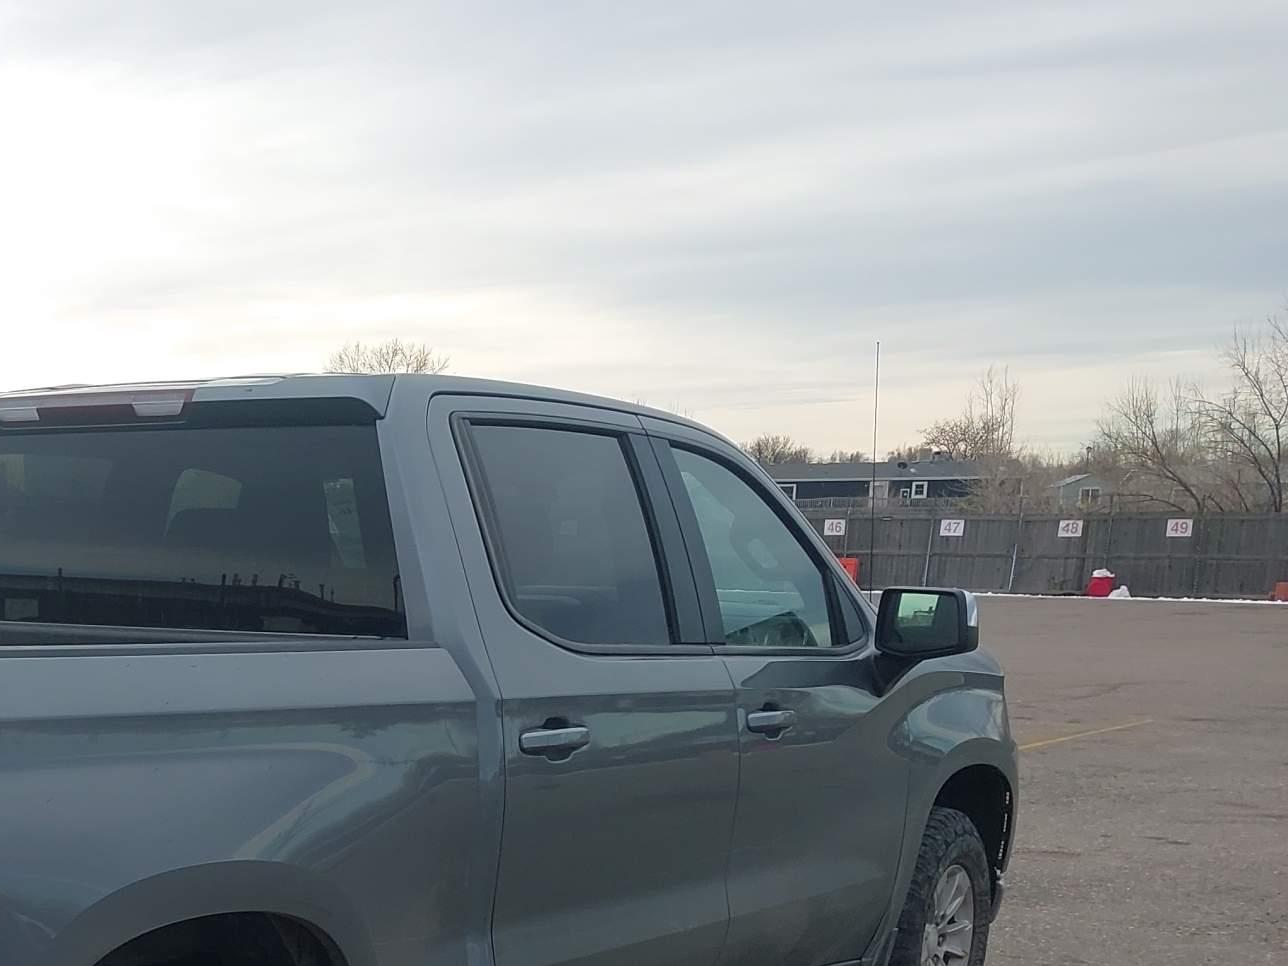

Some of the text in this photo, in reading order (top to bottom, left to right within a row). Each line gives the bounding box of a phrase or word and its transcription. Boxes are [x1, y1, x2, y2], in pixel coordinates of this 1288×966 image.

[827, 521, 842, 533] 46
[944, 521, 961, 533] 47
[1062, 521, 1079, 534] 48
[1170, 521, 1189, 534] 49
